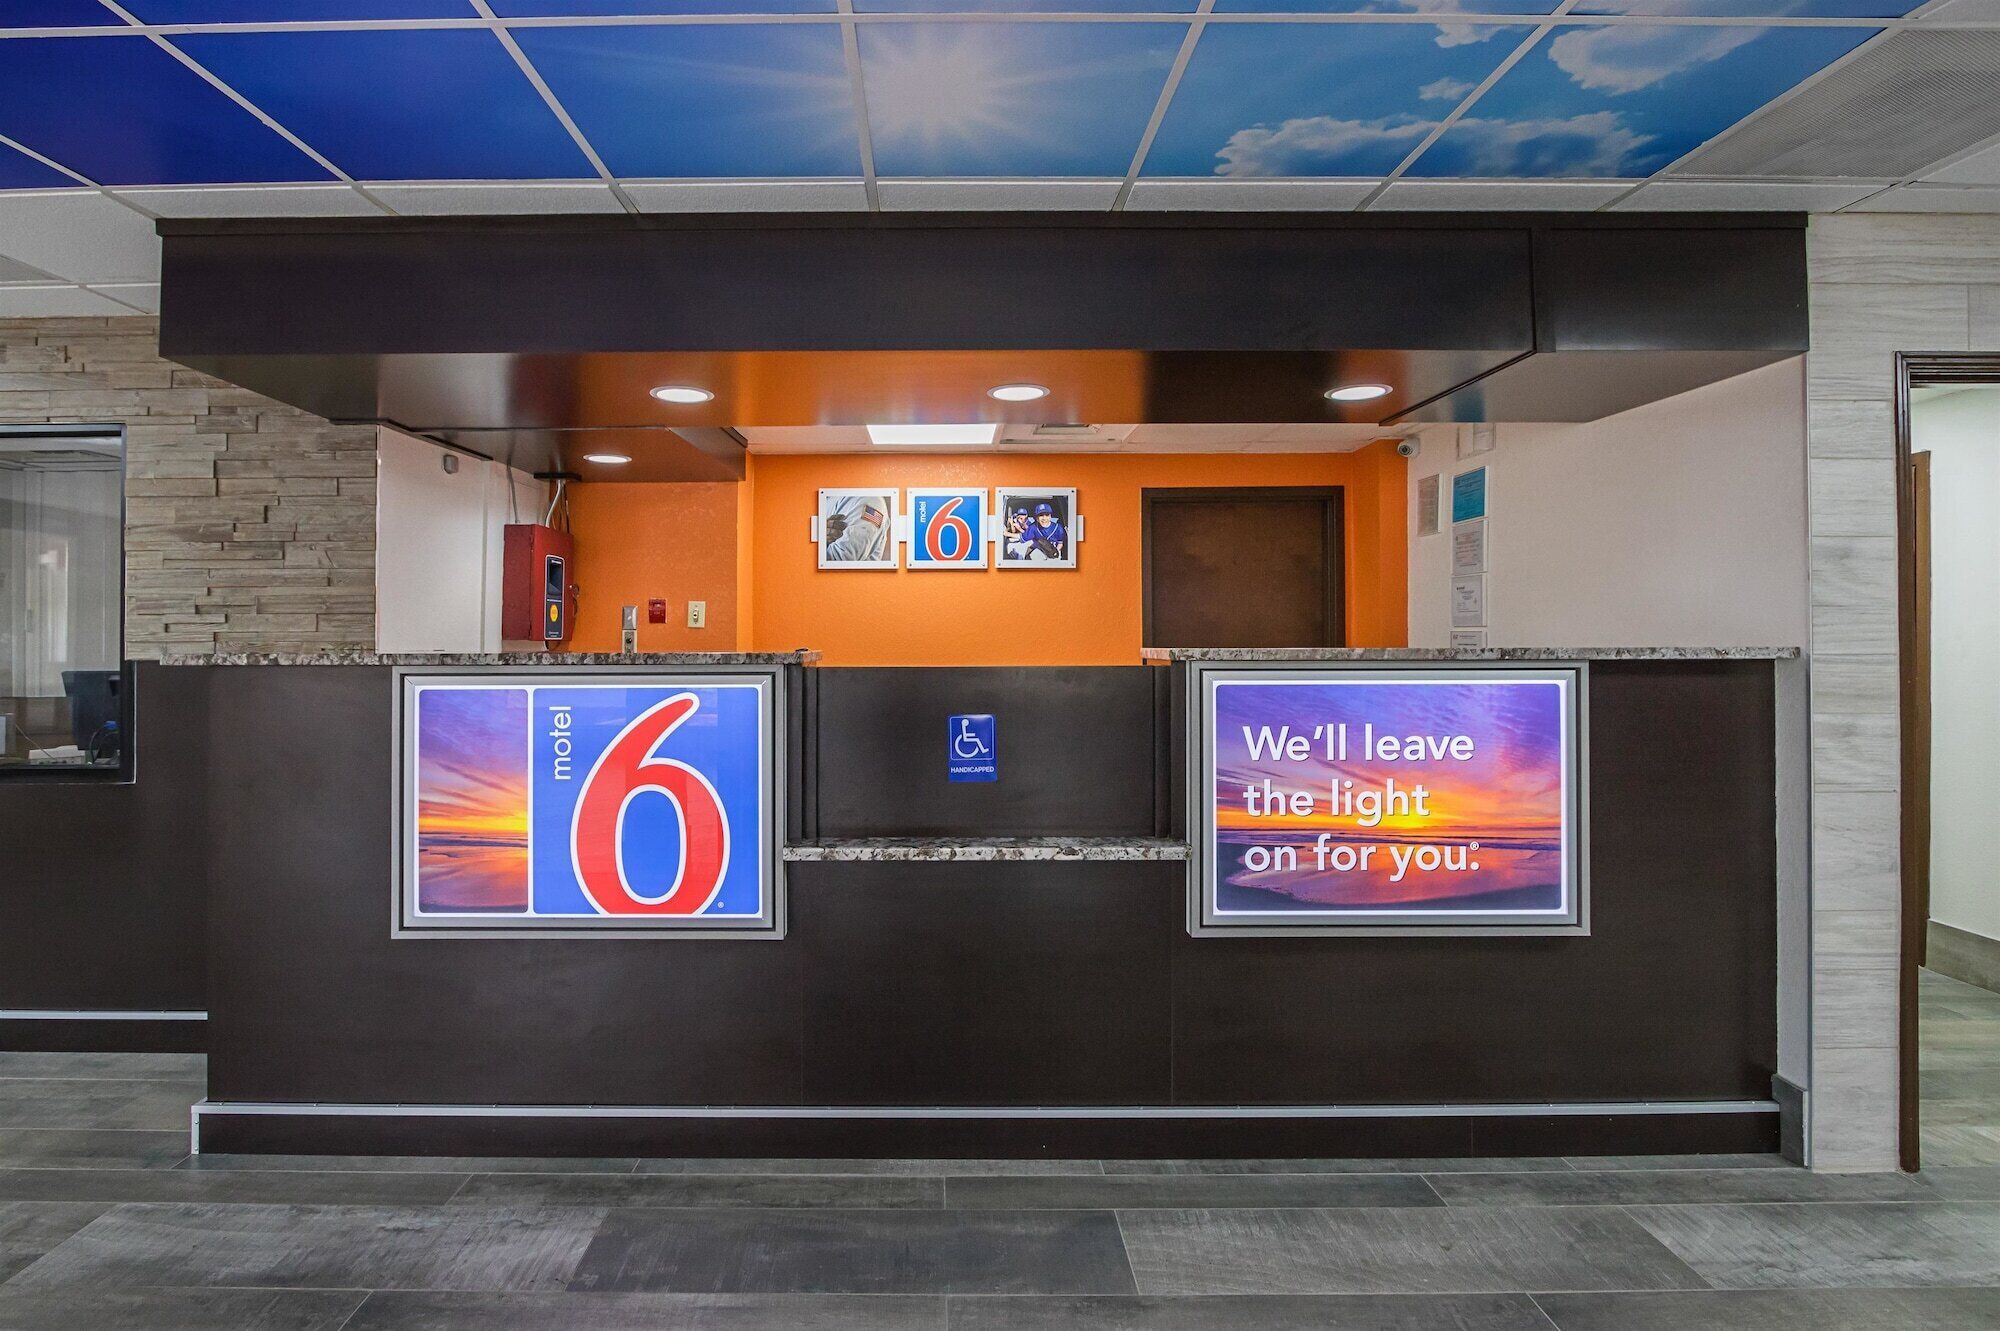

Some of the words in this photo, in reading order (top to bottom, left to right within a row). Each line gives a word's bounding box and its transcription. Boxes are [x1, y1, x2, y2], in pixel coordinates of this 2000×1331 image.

[925, 496, 972, 561] 6
[549, 706, 571, 780] motel
[1242, 723, 1347, 761] We'll
[1365, 723, 1475, 761] leave
[570, 691, 731, 915] 6
[1242, 778, 1314, 817] the
[1331, 778, 1431, 827] light
[1244, 845, 1297, 872] on
[1313, 833, 1377, 872] for
